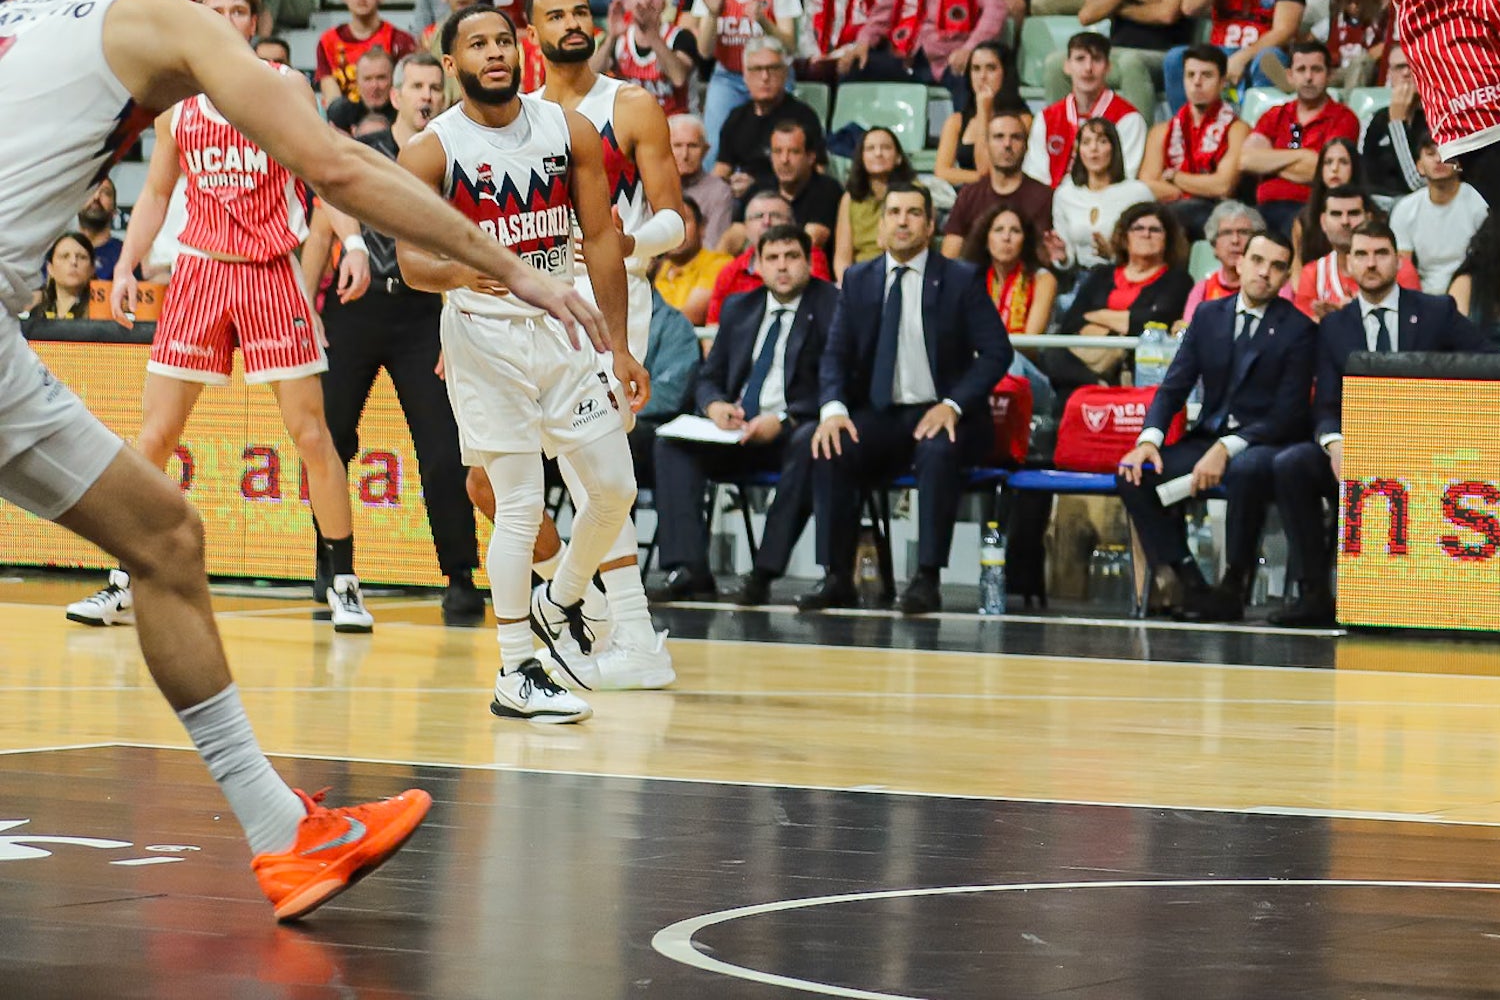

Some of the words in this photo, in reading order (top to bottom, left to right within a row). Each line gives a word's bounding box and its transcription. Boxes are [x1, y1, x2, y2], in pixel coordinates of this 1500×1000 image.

[186, 146, 268, 174] UCAM
[198, 172, 255, 189] MURCIA
[572, 407, 609, 429] HYUNDAI
